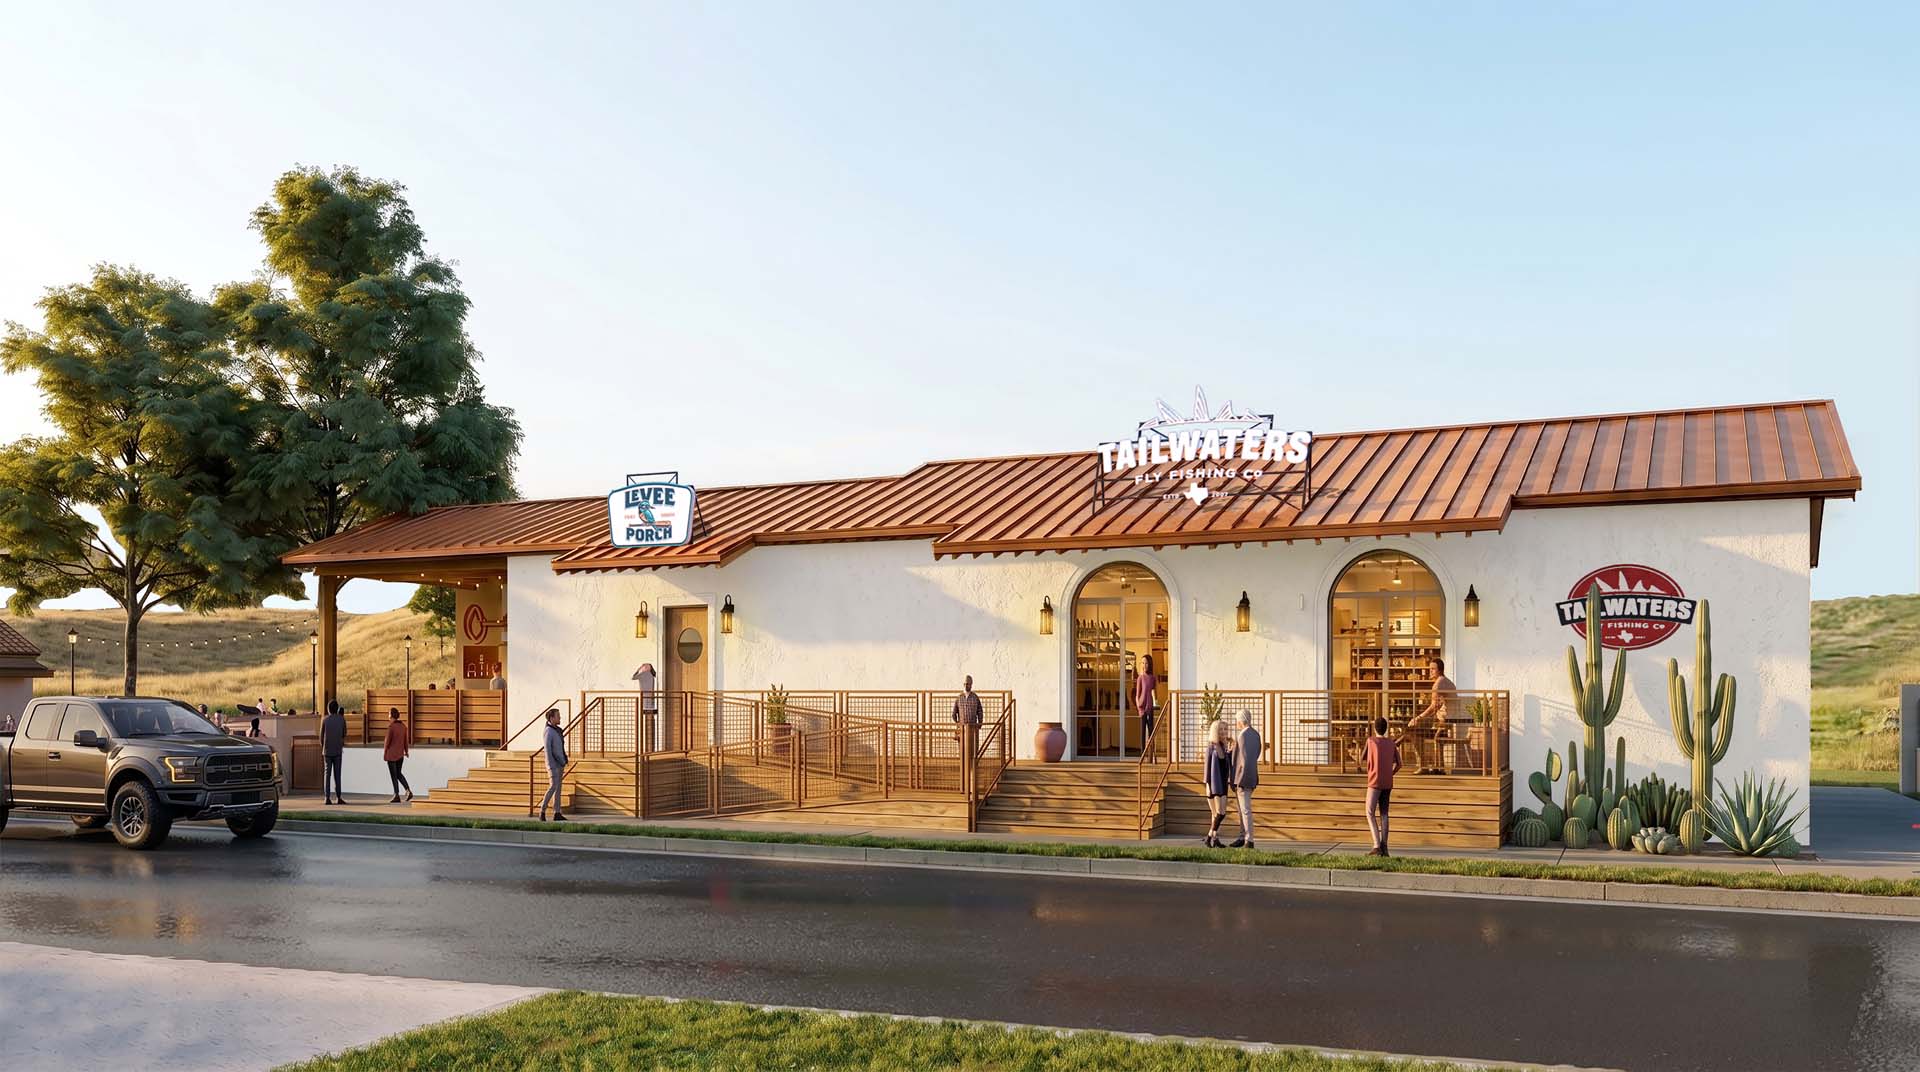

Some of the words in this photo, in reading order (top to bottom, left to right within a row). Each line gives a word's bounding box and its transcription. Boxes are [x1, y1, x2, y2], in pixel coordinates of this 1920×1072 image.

[1097, 429, 1312, 473] TAILWATERS
[1134, 472, 1161, 485] FLY
[1169, 468, 1236, 480] FISHING
[624, 488, 676, 508] LEVEE
[626, 527, 672, 542] PORCH
[1560, 598, 1692, 621] TAWATERS
